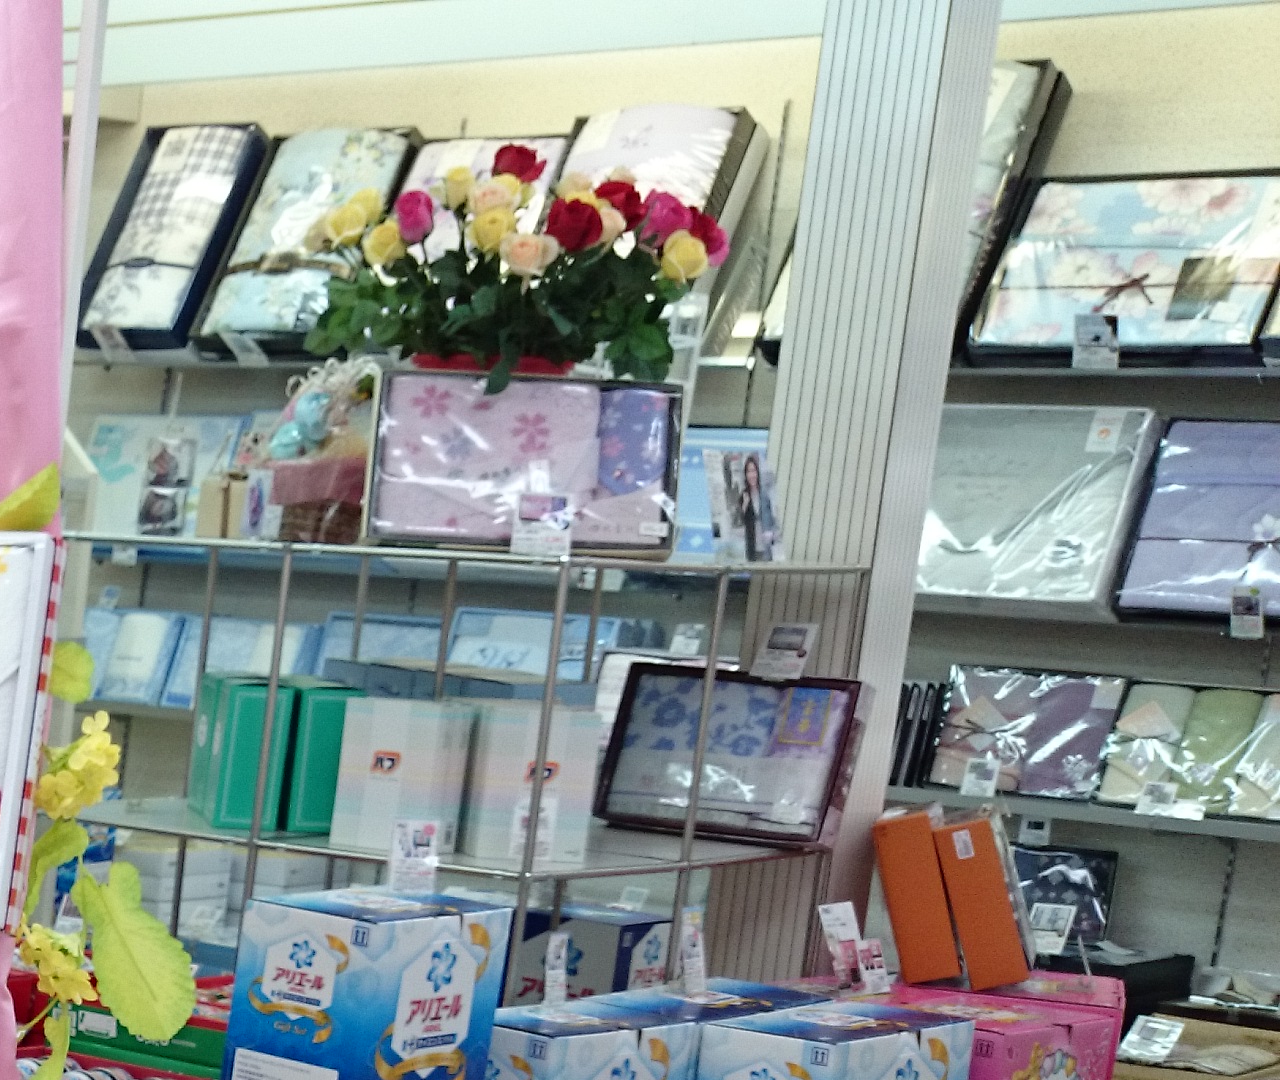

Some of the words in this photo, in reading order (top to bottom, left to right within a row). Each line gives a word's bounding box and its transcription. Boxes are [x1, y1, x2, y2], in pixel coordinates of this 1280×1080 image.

[271, 966, 324, 991] アリエール
[404, 994, 463, 1026] アリエール
